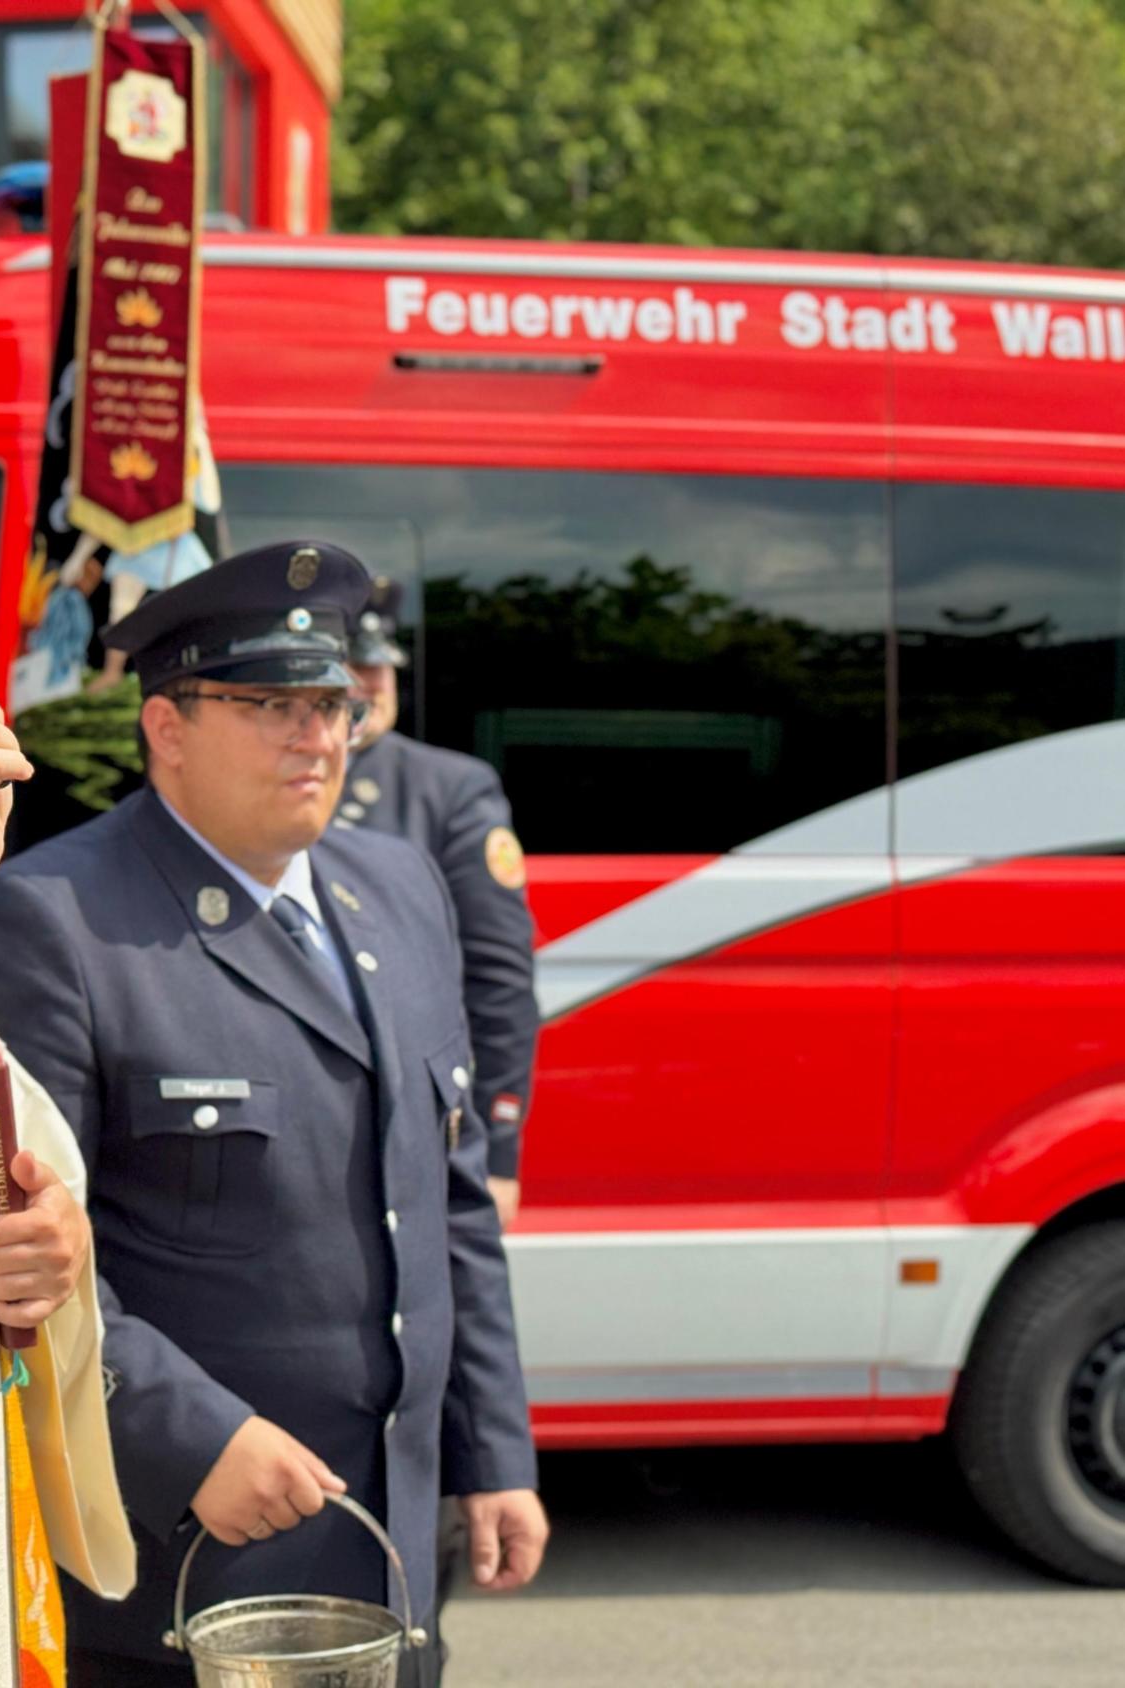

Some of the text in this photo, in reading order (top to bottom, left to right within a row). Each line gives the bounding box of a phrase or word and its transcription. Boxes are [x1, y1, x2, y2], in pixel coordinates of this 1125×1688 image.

[385, 276, 1125, 362] Feuerwehr Stadt Wall
